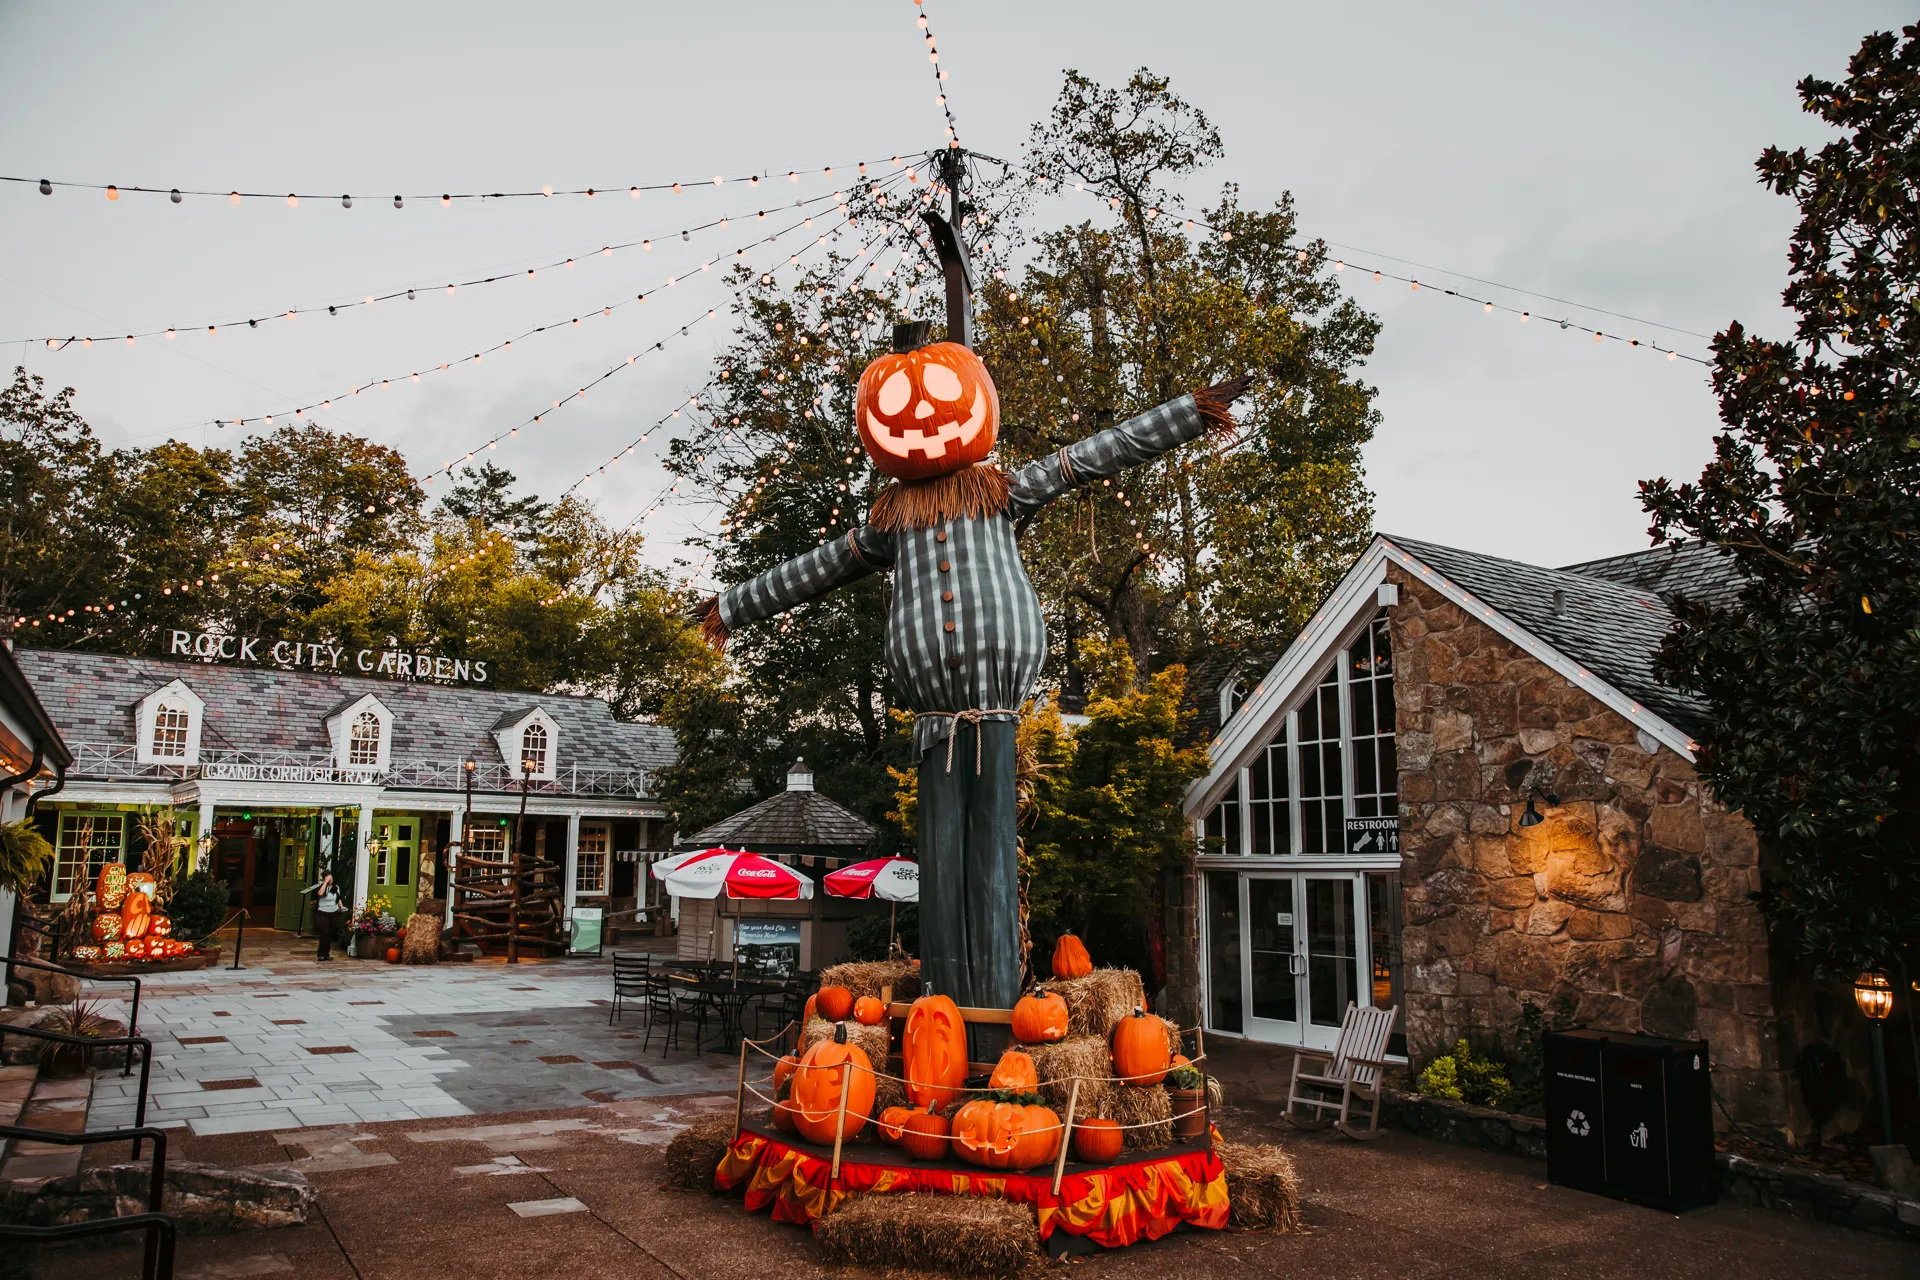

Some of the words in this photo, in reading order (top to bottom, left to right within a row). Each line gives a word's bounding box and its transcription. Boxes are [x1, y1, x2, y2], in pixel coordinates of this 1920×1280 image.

[171, 630, 260, 661] ROCK
[273, 641, 344, 668] CITY
[357, 649, 487, 682] GARDENS
[206, 763, 257, 780] GRAND
[259, 765, 334, 783] CORRIDOR
[1347, 820, 1399, 830] RESTROOM
[737, 868, 777, 878] Coca-Cola
[775, 924, 787, 932] City
